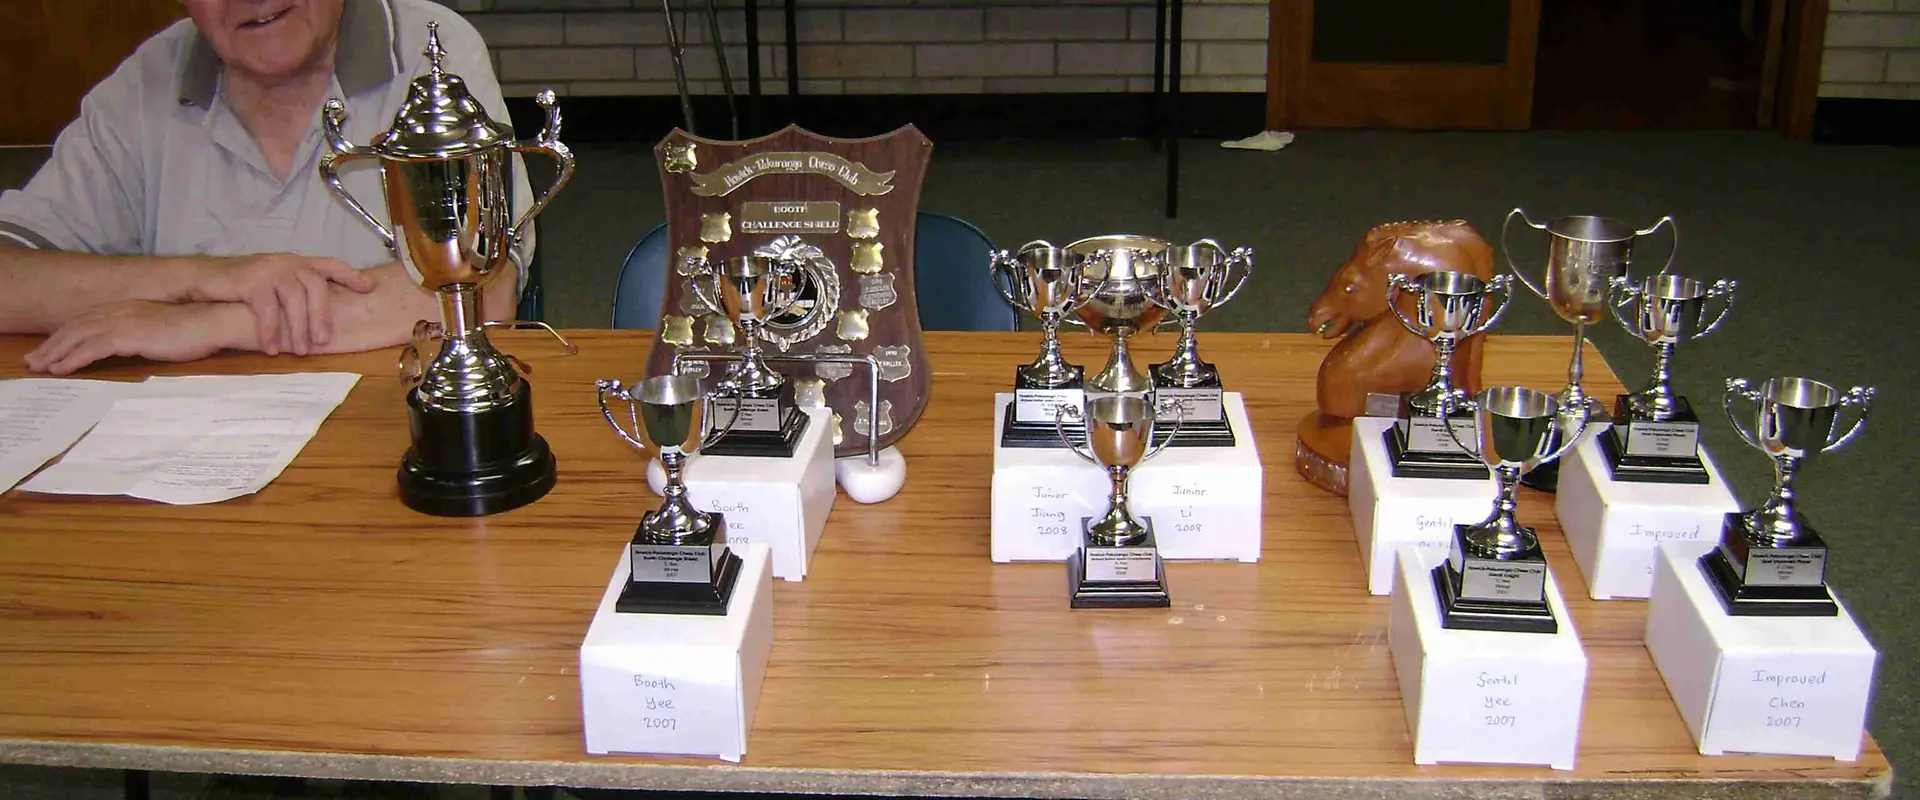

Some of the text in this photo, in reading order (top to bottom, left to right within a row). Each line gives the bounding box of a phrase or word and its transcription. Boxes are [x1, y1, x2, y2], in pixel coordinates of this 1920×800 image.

[808, 156, 835, 172] Chess
[838, 164, 858, 186] Club
[741, 220, 839, 229] CHALLENGE SHIELD
[1031, 486, 1069, 499] Junior
[1171, 482, 1207, 496] Junior
[711, 499, 749, 513] Booth
[1180, 505, 1193, 518] Li
[1029, 507, 1066, 523] Jiang
[1037, 526, 1068, 535] 2008
[1174, 523, 1203, 533] 2008
[634, 674, 676, 691] Booth
[1751, 669, 1826, 687] Improved
[1768, 696, 1805, 709] Chen
[643, 716, 677, 731] 2007
[1485, 715, 1516, 728] 2007
[1766, 716, 1802, 728] 2007
